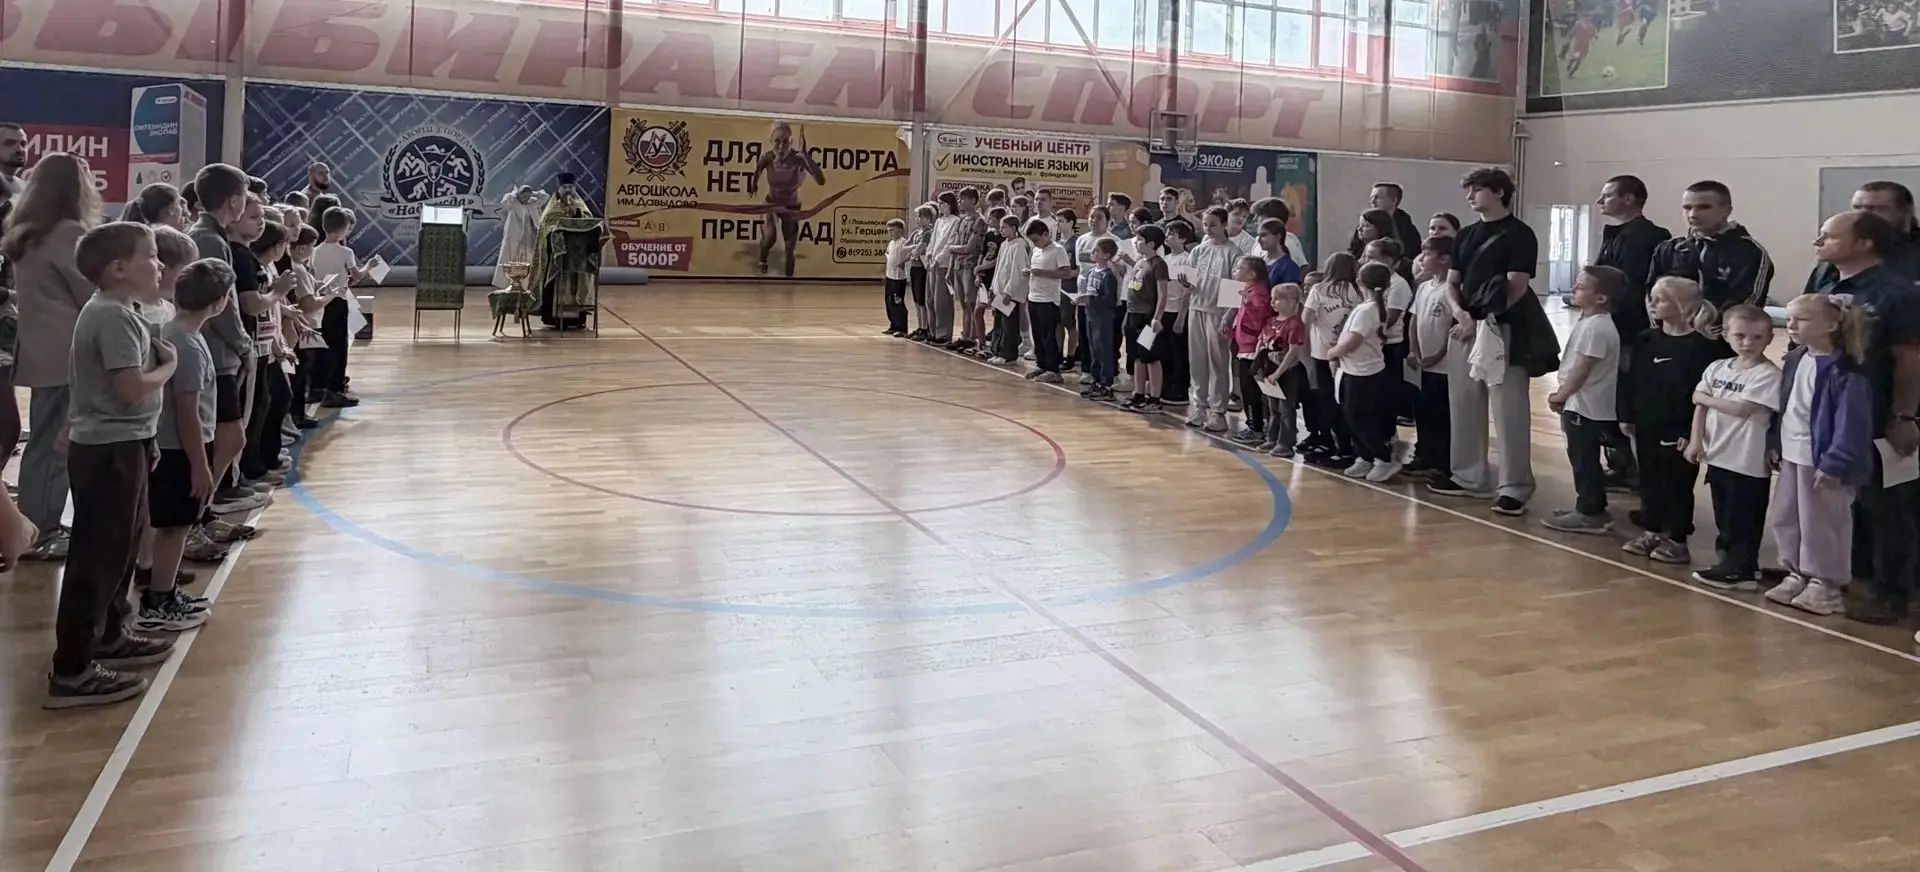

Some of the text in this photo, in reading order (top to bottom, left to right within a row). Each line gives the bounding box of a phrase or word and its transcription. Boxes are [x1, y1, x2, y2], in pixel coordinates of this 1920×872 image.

[0, 0, 1325, 138] ЫБИРАЕМ СПОРТ
[27, 134, 109, 158] ИДИН
[703, 139, 899, 171] ДЛЯ СПОРТА
[975, 136, 1091, 156] УЧЕБНЫЙ ЦЕНТР
[953, 153, 1045, 170] ИНОСТРАННЫЕ
[1047, 159, 1089, 172] ЯЗЫКИ
[1198, 152, 1244, 169] ЭКОлаб
[617, 183, 698, 198] АВТОШКОЛА
[706, 170, 757, 193] НЕТ
[701, 218, 833, 246] ПРЕГАД
[855, 226, 889, 236] Герцен
[621, 242, 687, 252] ОБУЧЕНИЕ ОТ
